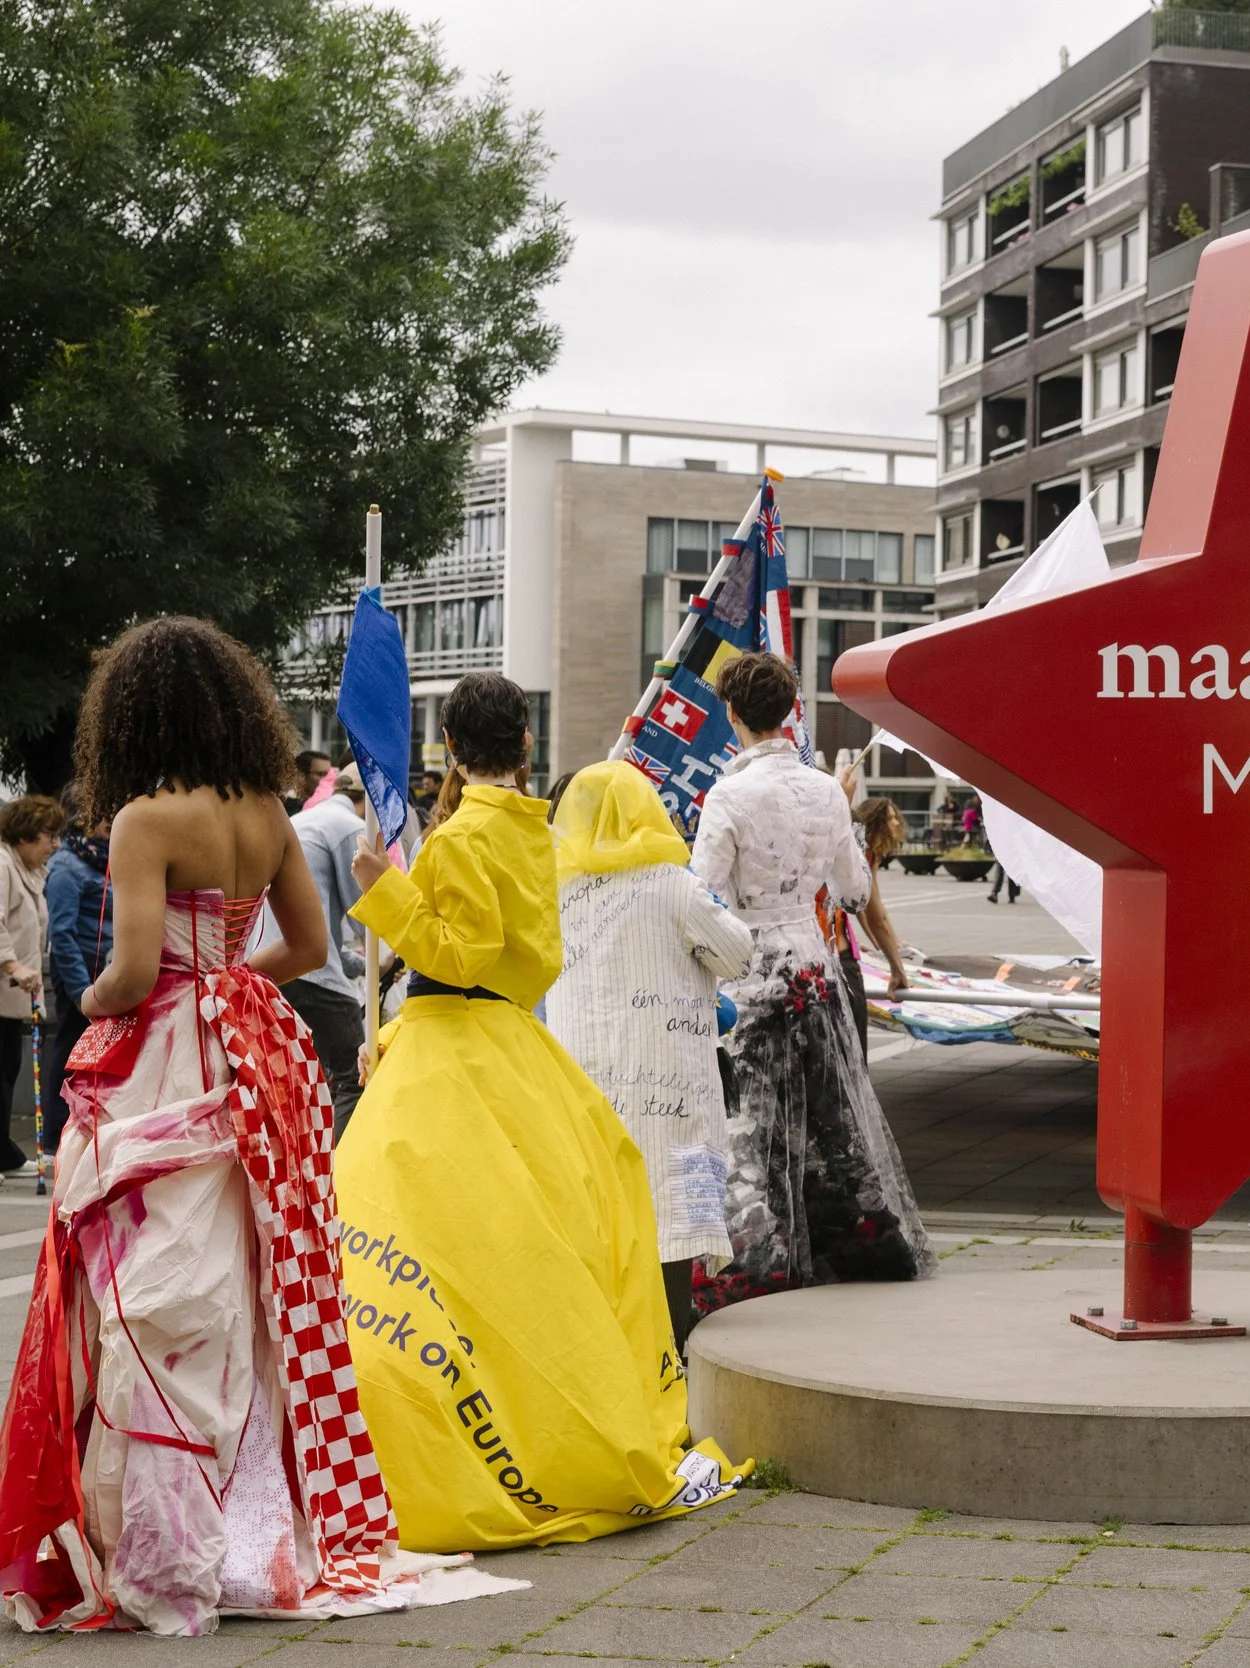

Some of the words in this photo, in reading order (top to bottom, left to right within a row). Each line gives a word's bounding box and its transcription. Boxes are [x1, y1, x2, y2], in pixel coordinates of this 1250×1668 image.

[560, 875, 612, 914] uropa
[639, 1094, 689, 1119] steek
[455, 1388, 559, 1514] Europe
